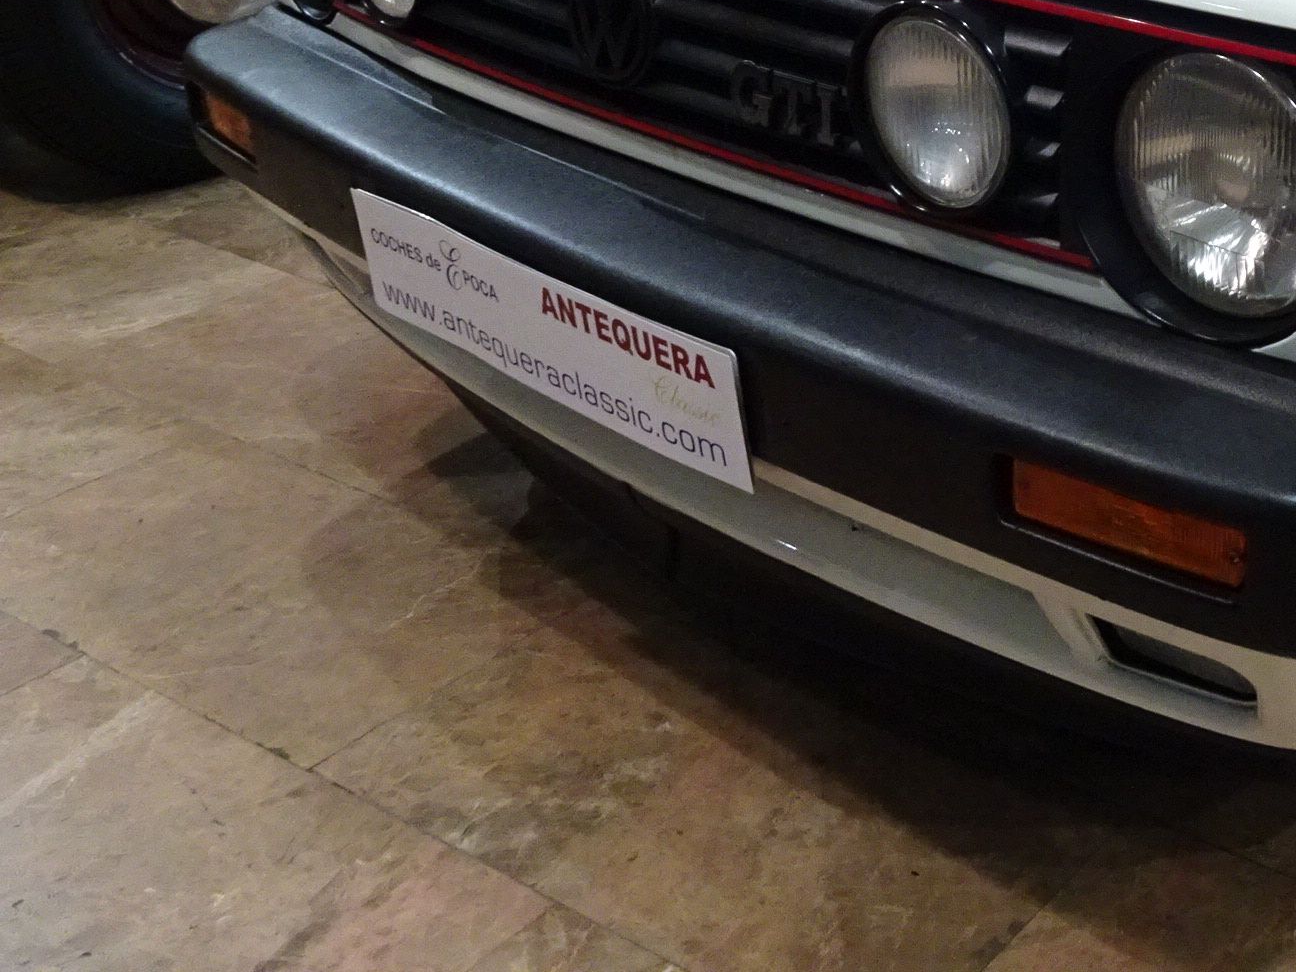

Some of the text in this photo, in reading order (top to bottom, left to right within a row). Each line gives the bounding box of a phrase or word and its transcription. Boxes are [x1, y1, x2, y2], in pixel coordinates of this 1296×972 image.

[732, 59, 847, 146] GTI
[371, 228, 423, 264] COCHES
[426, 253, 442, 271] de
[382, 280, 728, 467] www.antequeraclassic.com
[541, 286, 716, 390] ANTEQUERA
